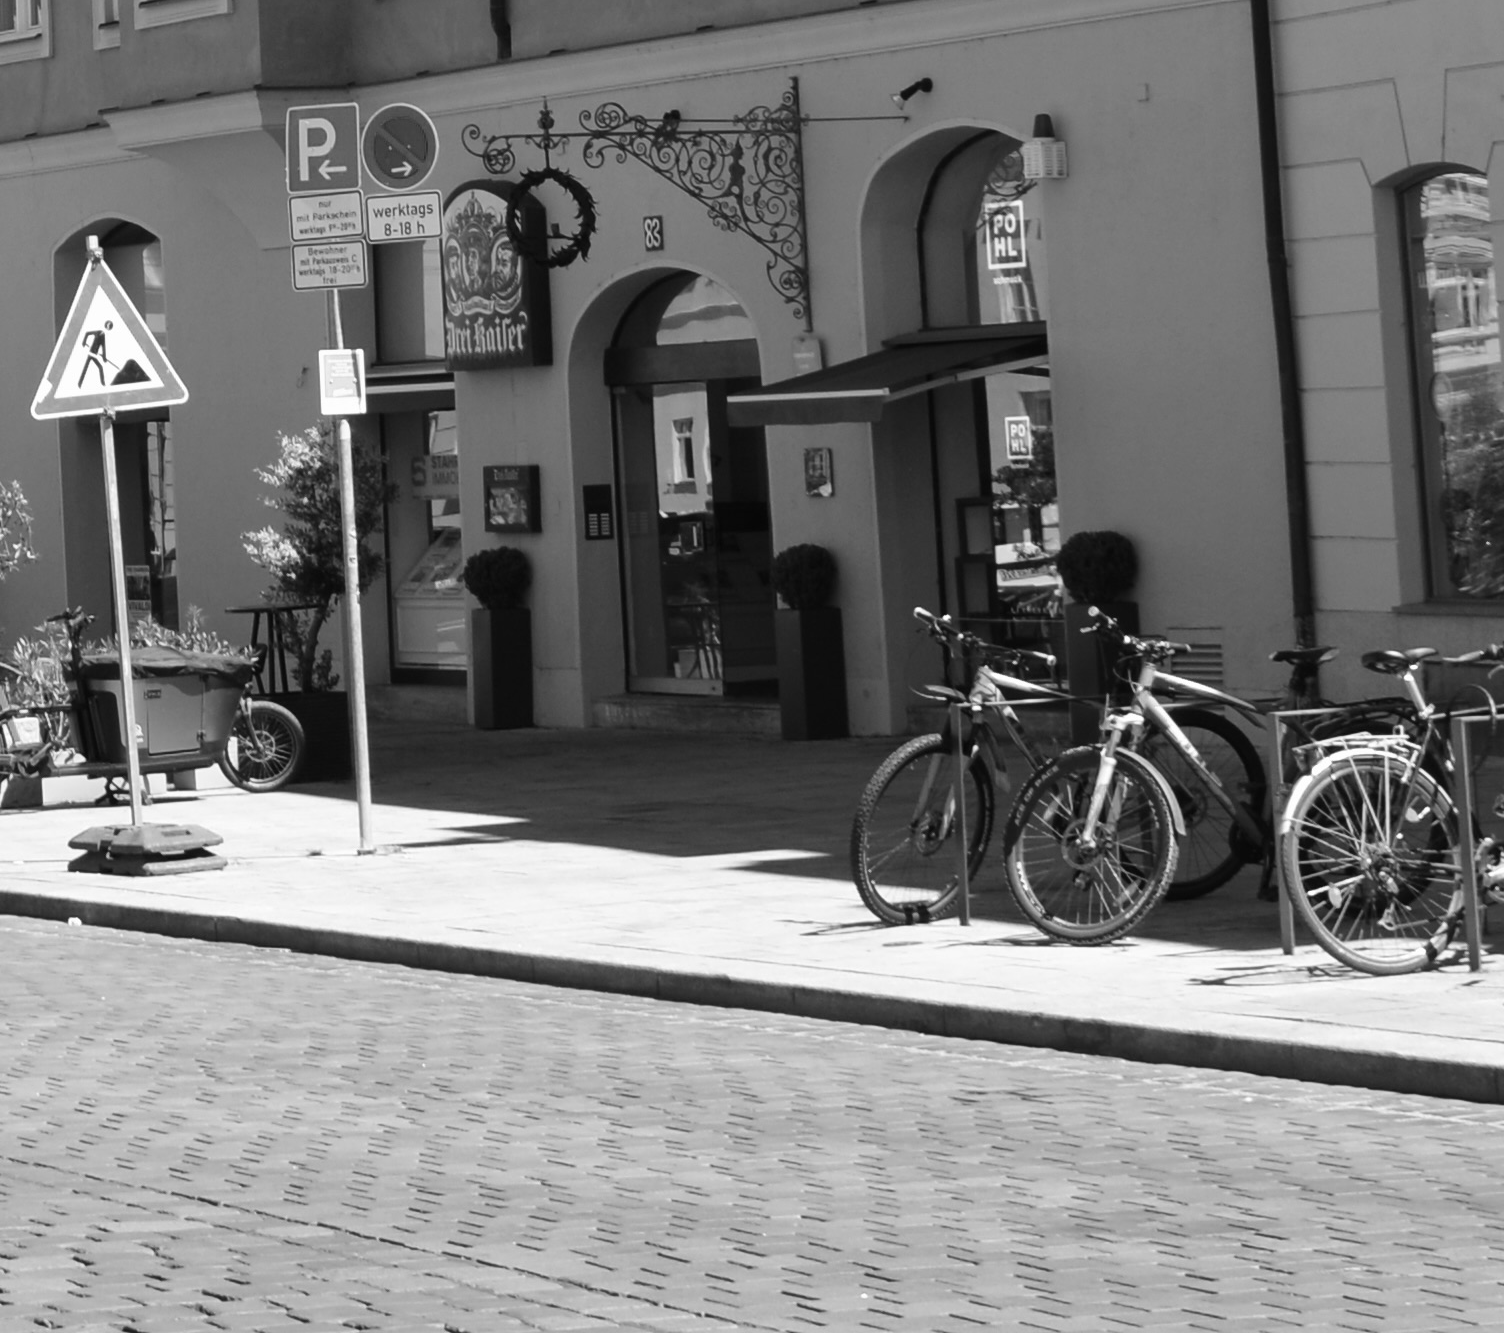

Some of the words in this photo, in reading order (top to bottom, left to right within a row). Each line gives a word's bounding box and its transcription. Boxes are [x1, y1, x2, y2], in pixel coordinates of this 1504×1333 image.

[298, 117, 337, 182] P
[296, 214, 310, 222] mit
[312, 210, 357, 221] Parkschein
[372, 202, 434, 220] werktags
[384, 222, 412, 237] 8-18
[417, 221, 425, 234] h
[644, 218, 661, 248] 83
[307, 246, 348, 256] Bewohner
[994, 236, 1018, 257] HL
[351, 254, 357, 263] C
[298, 268, 326, 276] werktags
[322, 276, 337, 284] frei
